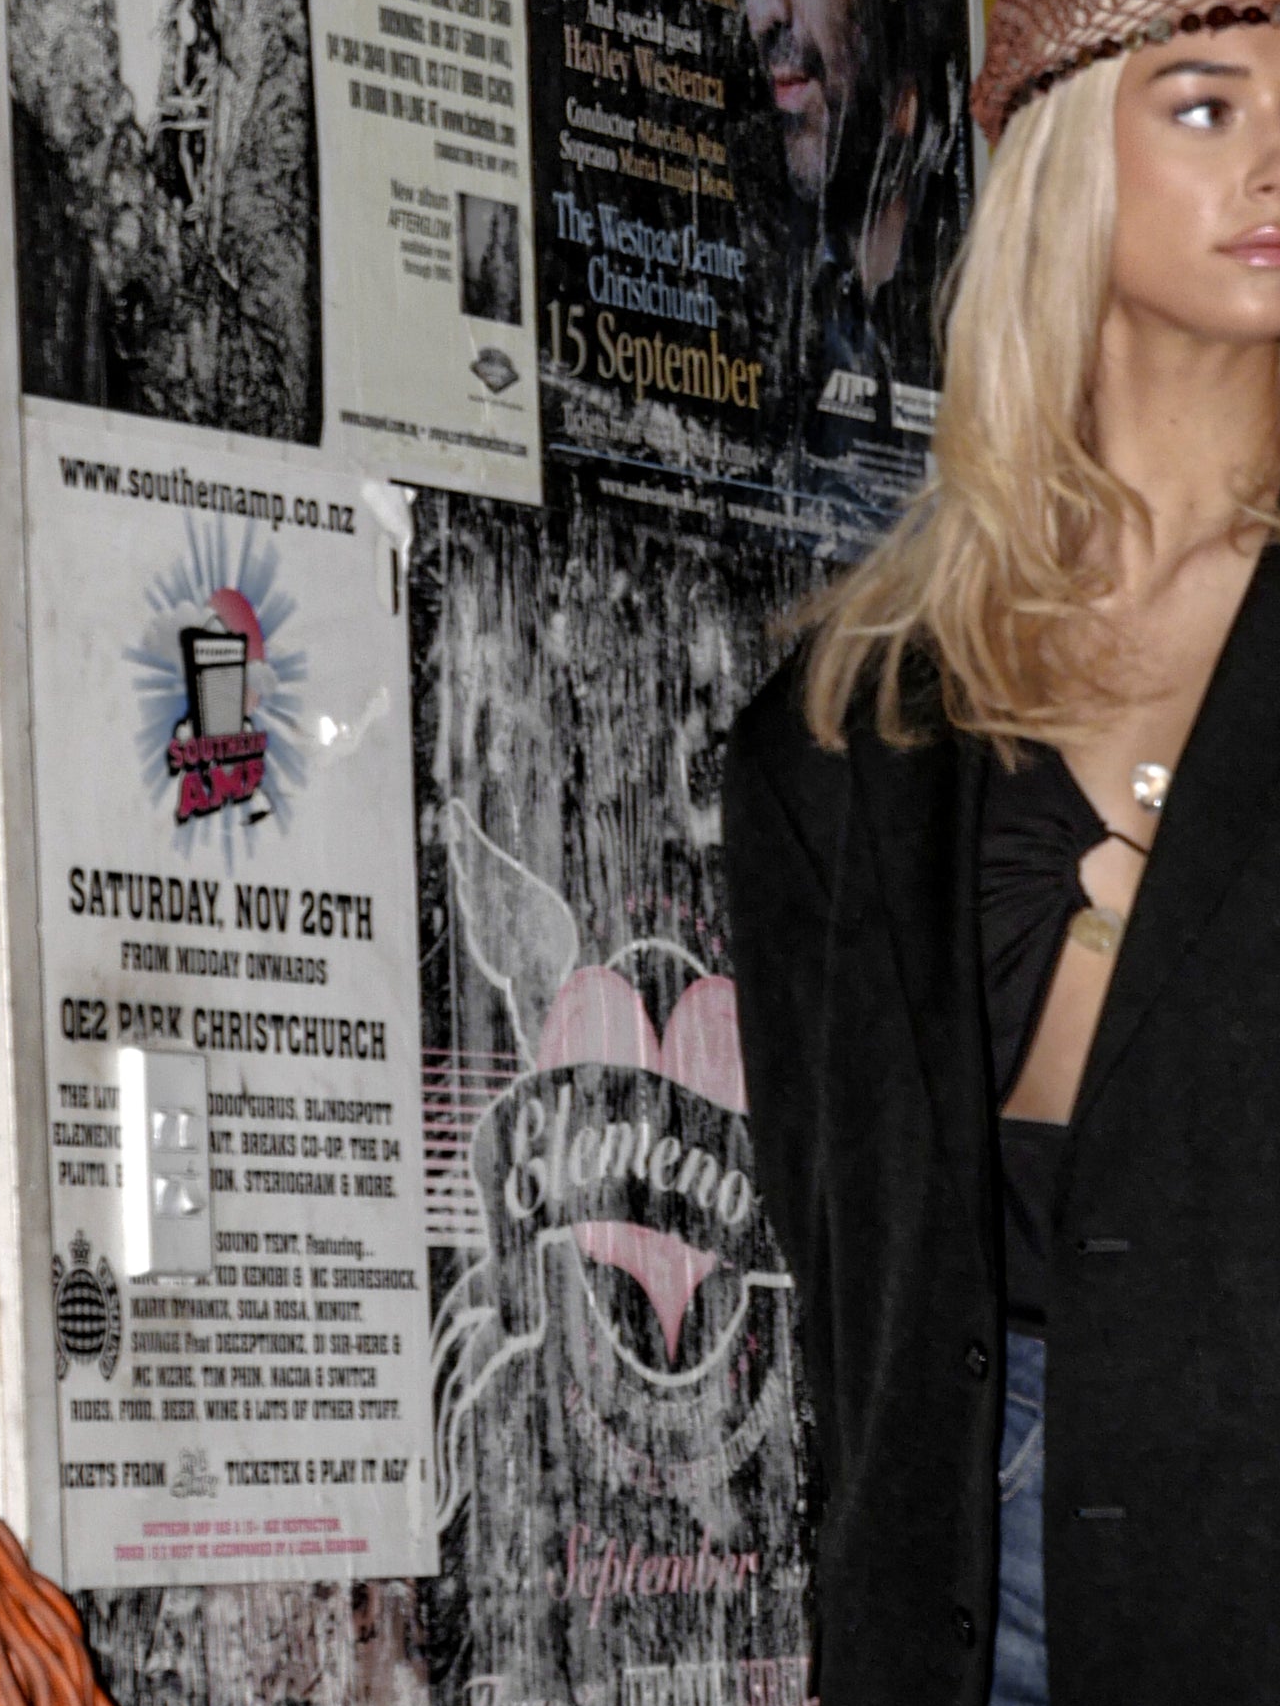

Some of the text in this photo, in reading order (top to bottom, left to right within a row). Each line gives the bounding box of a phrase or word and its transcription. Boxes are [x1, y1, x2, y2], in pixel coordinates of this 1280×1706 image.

[562, 22, 631, 96] Hayley
[566, 95, 637, 143] Conductor
[558, 128, 619, 173] Soprano
[552, 191, 747, 283] The Westpac Centre
[587, 254, 720, 330] Christchurch
[546, 298, 587, 378] 15
[596, 310, 763, 411] September
[58, 455, 356, 535] www.southernamp.co.nz
[176, 759, 267, 825] AMP
[70, 866, 373, 941] SATURDAY, NOV 26TH
[121, 941, 328, 986] FROM MIDDAY ONWARDS
[60, 996, 388, 1061] QE2 PARK CHRISTCHURCH
[305, 1099, 395, 1126] BLINDSPOTT
[241, 1130, 297, 1159] BREAKS
[351, 1137, 380, 1162] THE
[243, 1170, 337, 1197] STERIOGRAM
[215, 1231, 260, 1253] SOUND
[241, 1265, 290, 1287] KENOBI
[204, 1399, 240, 1422] WINE
[255, 1399, 290, 1422] LOTS
[292, 1399, 308, 1421] OF
[312, 1398, 355, 1422] OTHER
[122, 1459, 377, 1488] FROM TICKETEK PLAY IT
